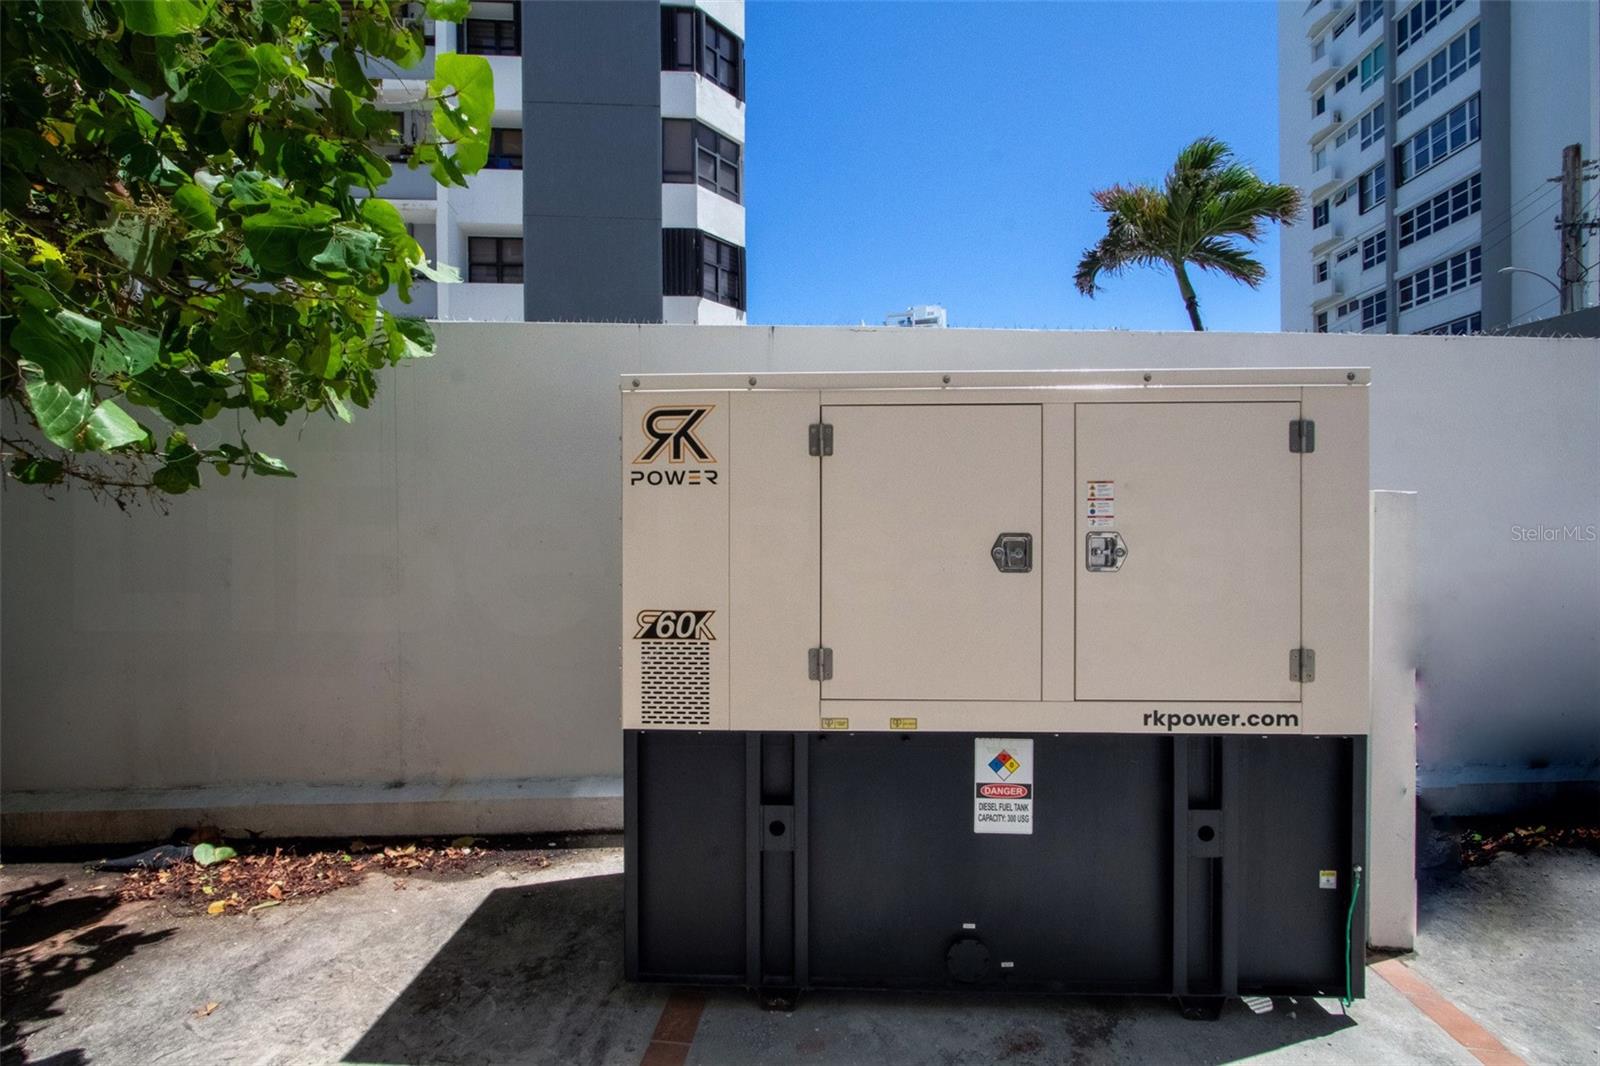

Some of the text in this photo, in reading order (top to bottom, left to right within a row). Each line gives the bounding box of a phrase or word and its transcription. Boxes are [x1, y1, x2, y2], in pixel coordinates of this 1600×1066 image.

[631, 470, 718, 485] POWER
[1143, 710, 1299, 731] rkpower.com
[984, 787, 1022, 795] DANGER
[979, 803, 1029, 811] DIESEL FUEL TANK
[978, 814, 1006, 822] CAPACITY:
[1017, 815, 1029, 823] USG
